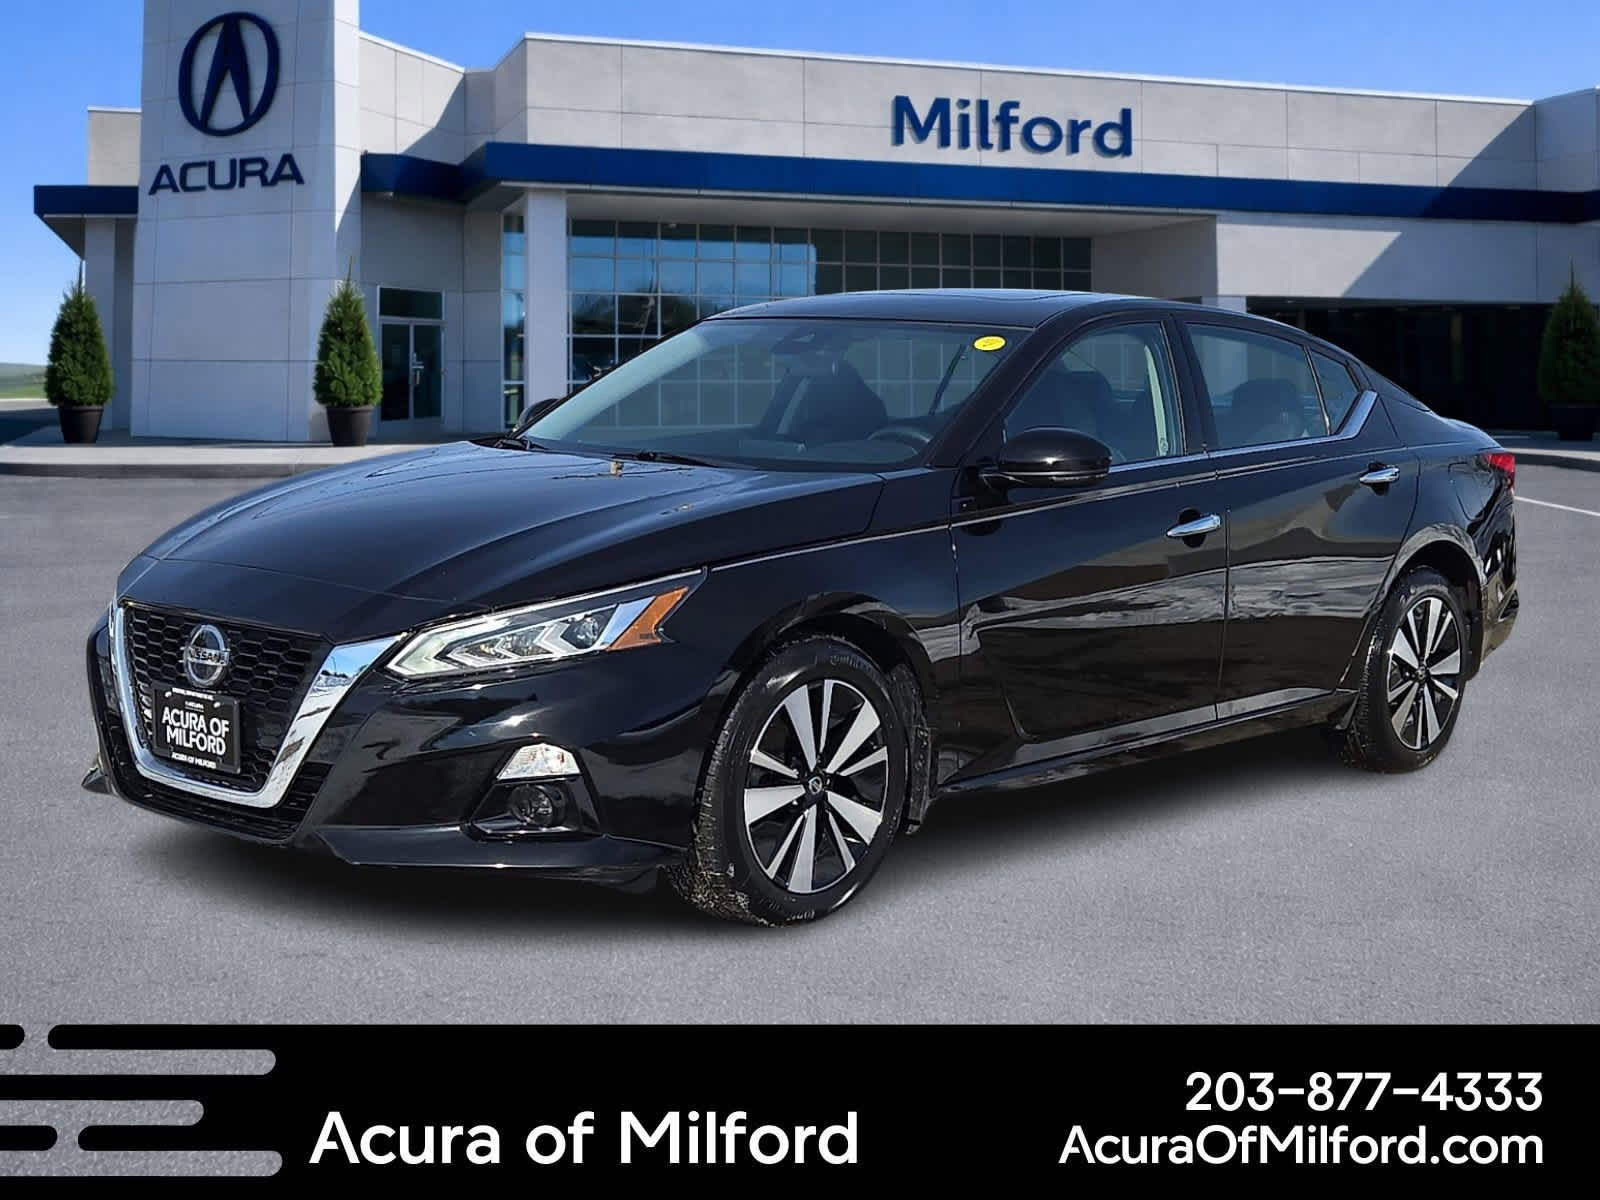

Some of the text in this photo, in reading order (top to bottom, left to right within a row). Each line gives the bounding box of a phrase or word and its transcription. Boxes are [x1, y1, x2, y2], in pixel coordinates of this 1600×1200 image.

[891, 95, 1133, 159] Milford
[149, 152, 306, 196] ACURA
[161, 706, 229, 738] ACURA OF
[166, 724, 226, 756] MILFORD
